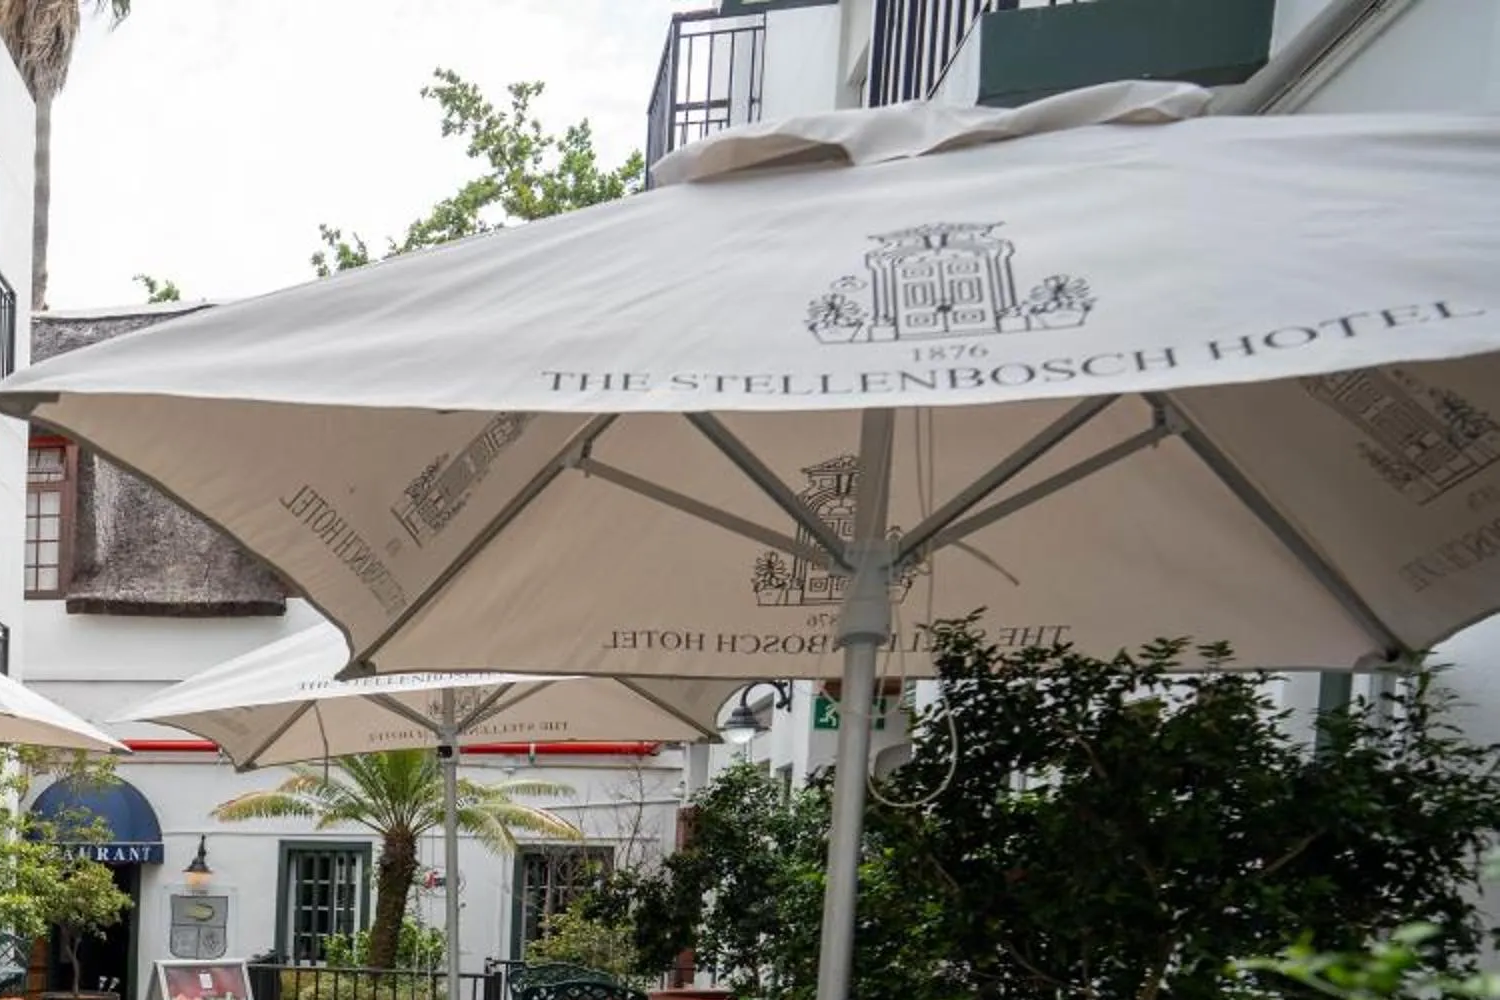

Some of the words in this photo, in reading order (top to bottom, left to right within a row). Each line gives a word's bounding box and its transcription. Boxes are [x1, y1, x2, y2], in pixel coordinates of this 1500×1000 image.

[541, 370, 652, 393] THE
[670, 346, 1178, 396] STELLENBOSCH
[1206, 299, 1487, 361] HOTEL
[910, 344, 989, 363] 1876
